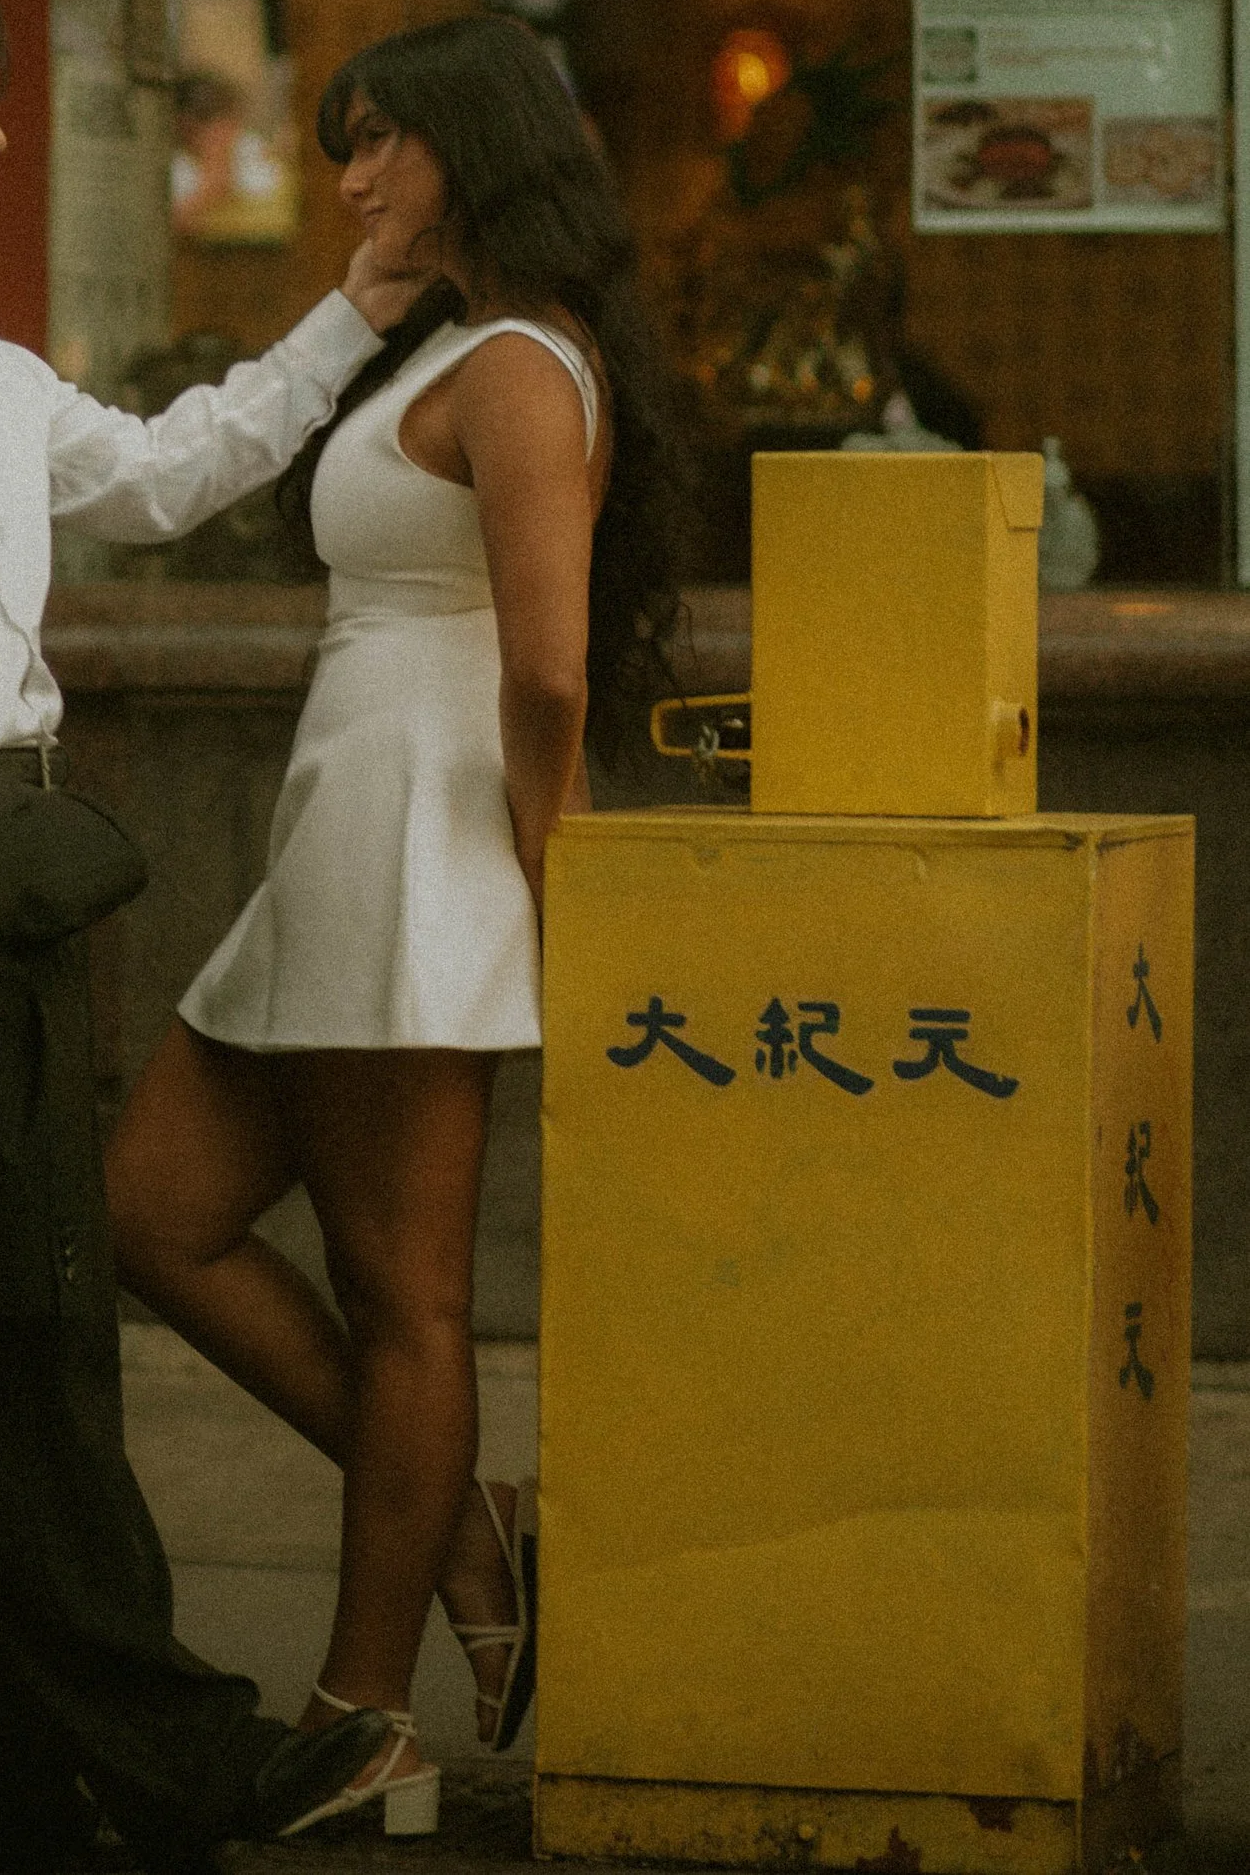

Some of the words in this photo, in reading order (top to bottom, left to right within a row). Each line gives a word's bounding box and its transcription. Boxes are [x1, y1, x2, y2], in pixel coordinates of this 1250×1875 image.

[606, 996, 1020, 1099] 大紀元
[1119, 941, 1163, 1401] 大紀元
